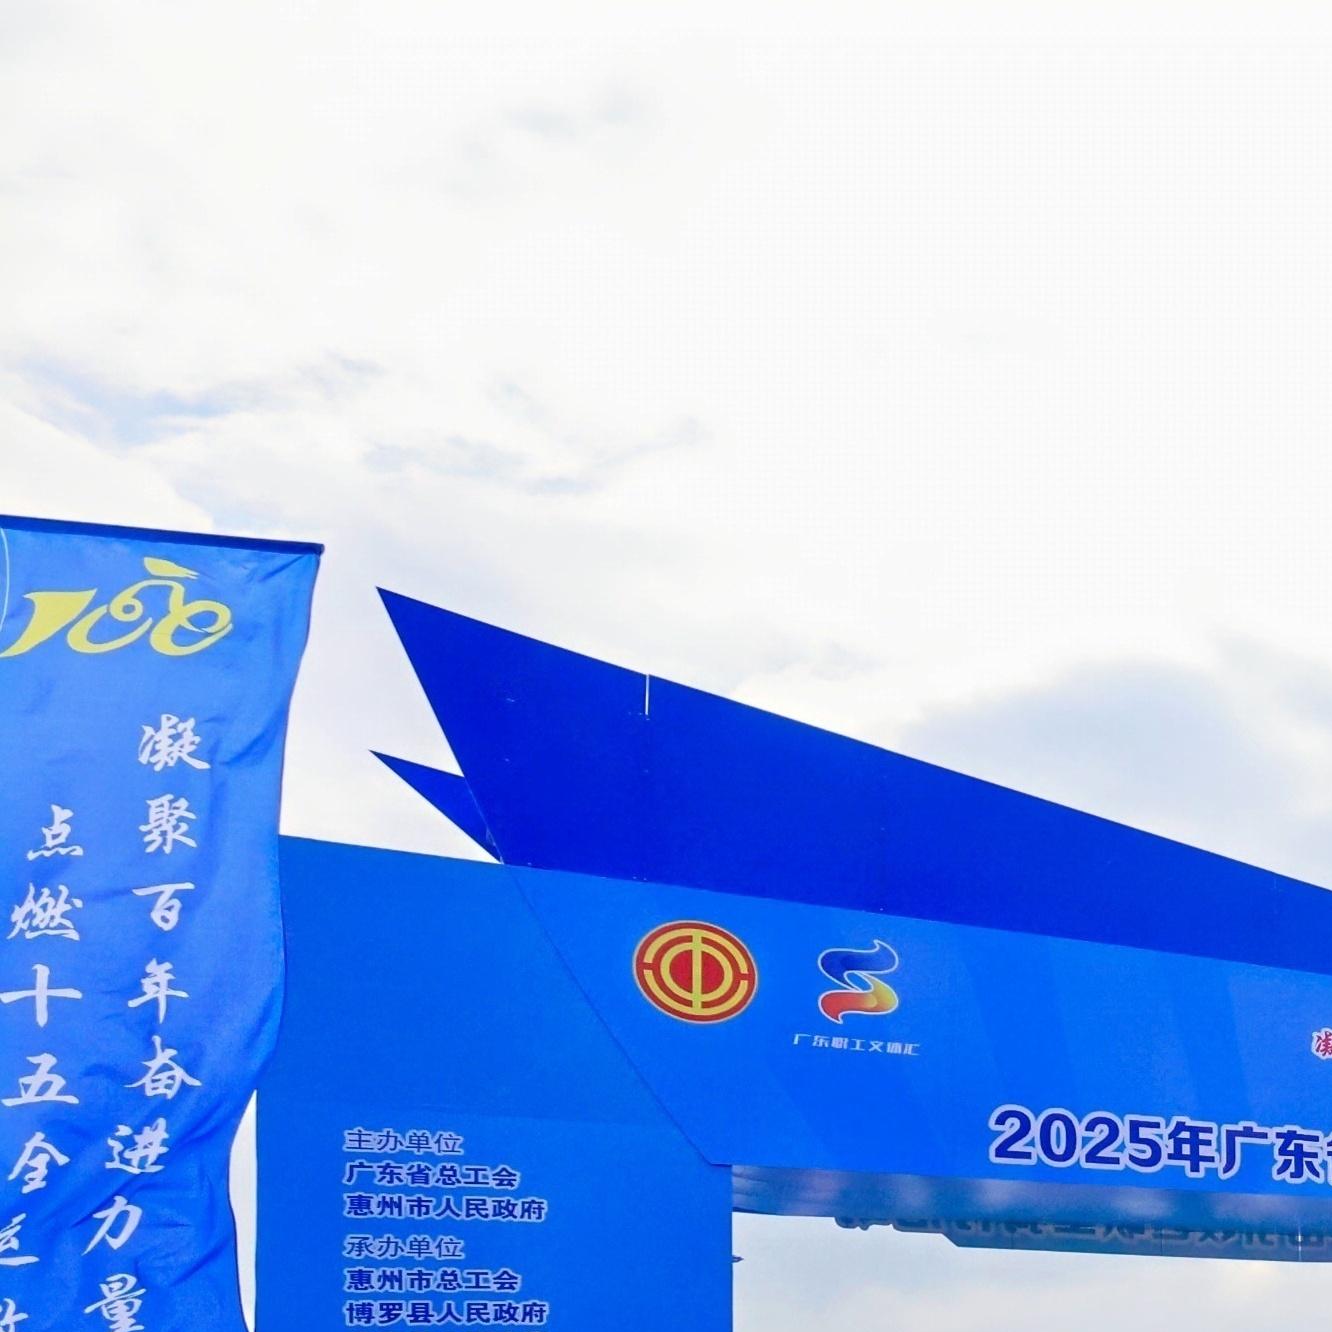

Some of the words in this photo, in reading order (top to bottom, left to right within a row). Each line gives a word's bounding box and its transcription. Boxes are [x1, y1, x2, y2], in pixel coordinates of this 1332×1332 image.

[345, 1128, 463, 1153] 主办单位
[345, 1160, 519, 1189] 广东省总工会
[345, 1194, 546, 1221] 惠州市人民政府
[345, 1235, 463, 1260] 承办单位
[345, 1268, 520, 1292] 惠州市总工会
[345, 1301, 547, 1324] 博罗县人民政府
